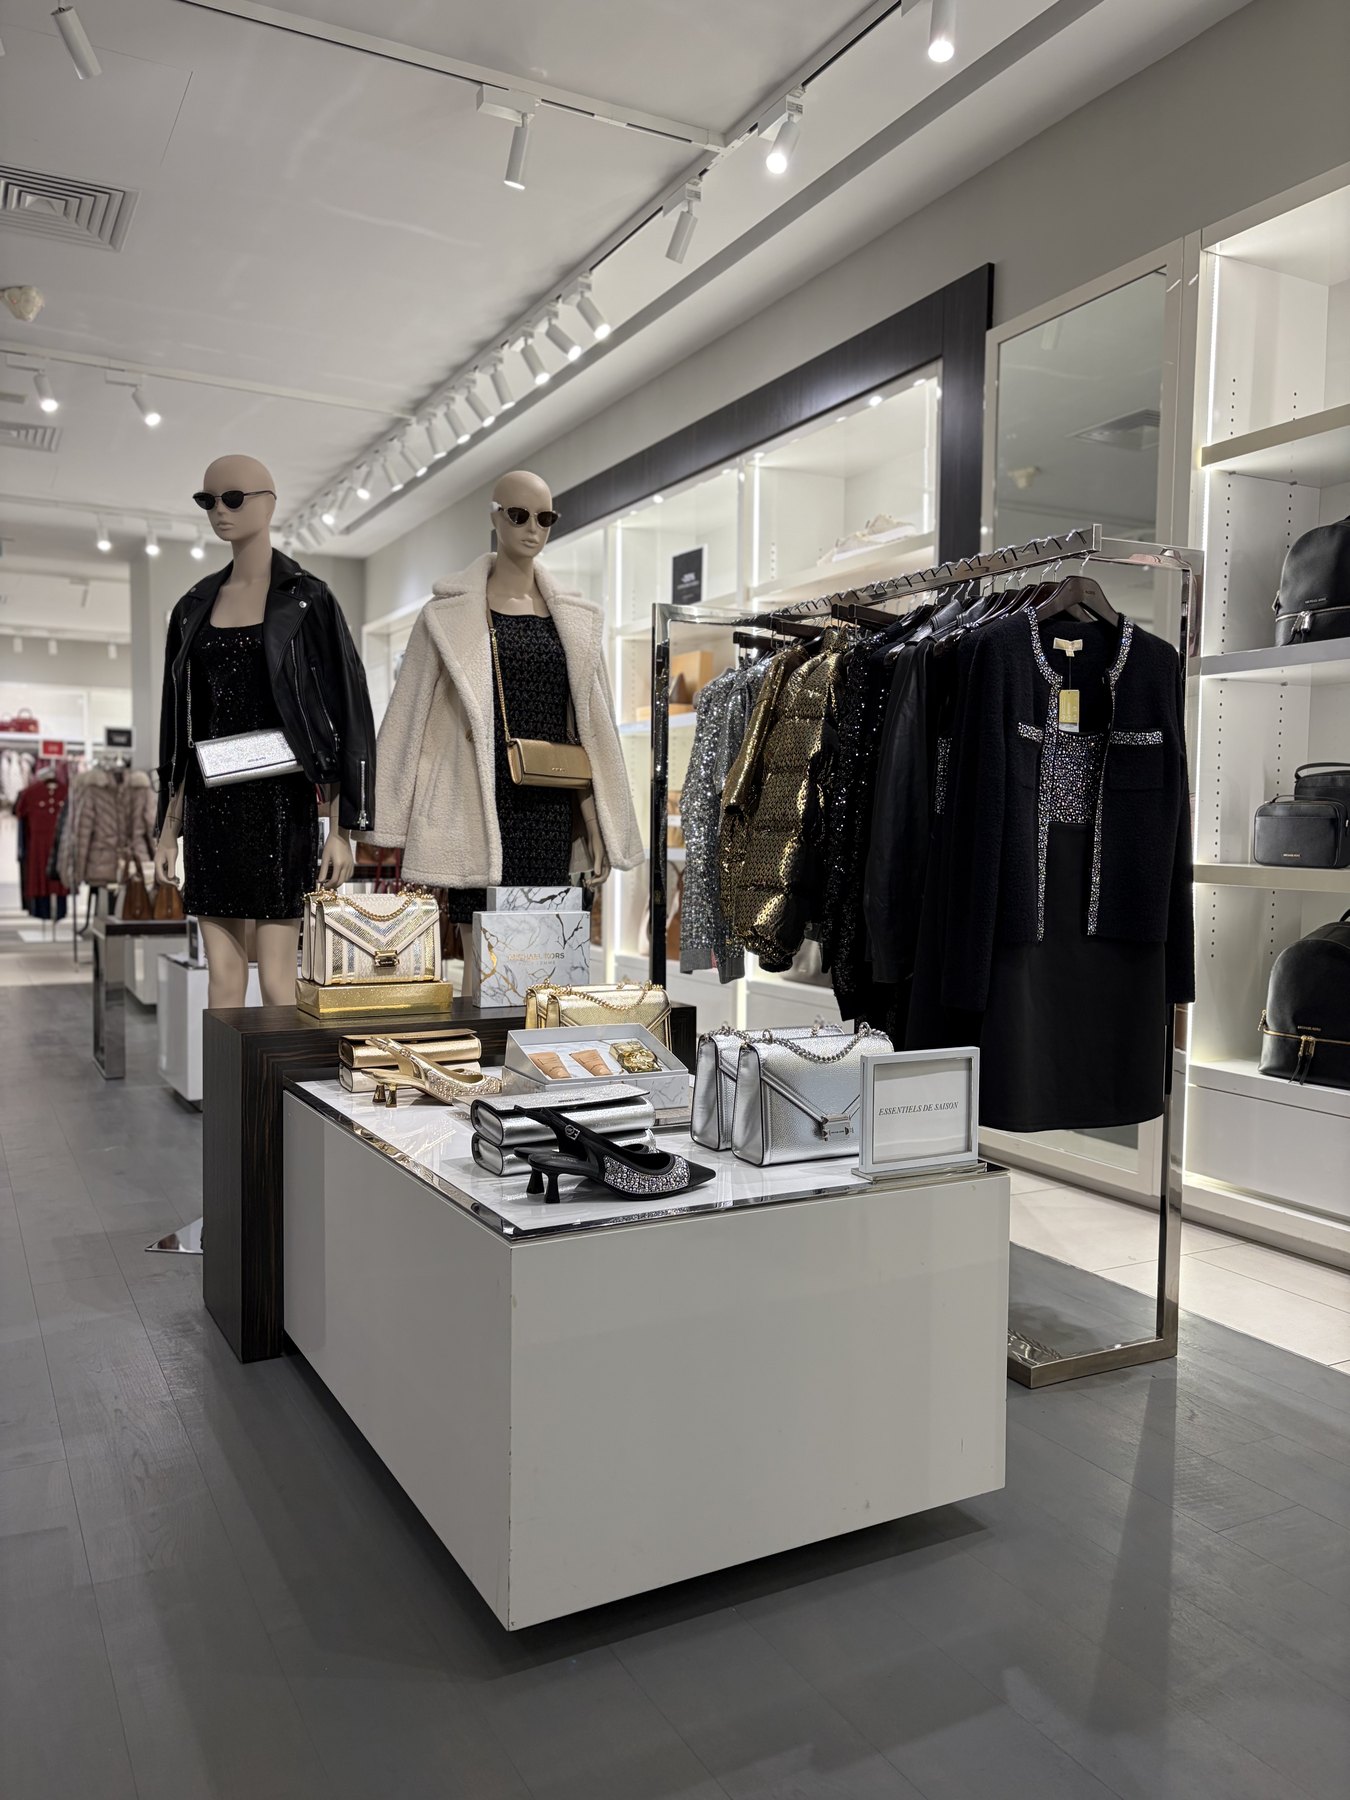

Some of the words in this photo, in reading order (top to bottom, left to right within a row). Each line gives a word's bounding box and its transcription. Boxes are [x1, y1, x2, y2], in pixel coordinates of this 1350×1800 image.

[544, 952, 565, 960] KORS
[878, 1105, 922, 1116] ESSENTIELS
[922, 1103, 933, 1112] DE
[934, 1101, 958, 1111] SAISON
